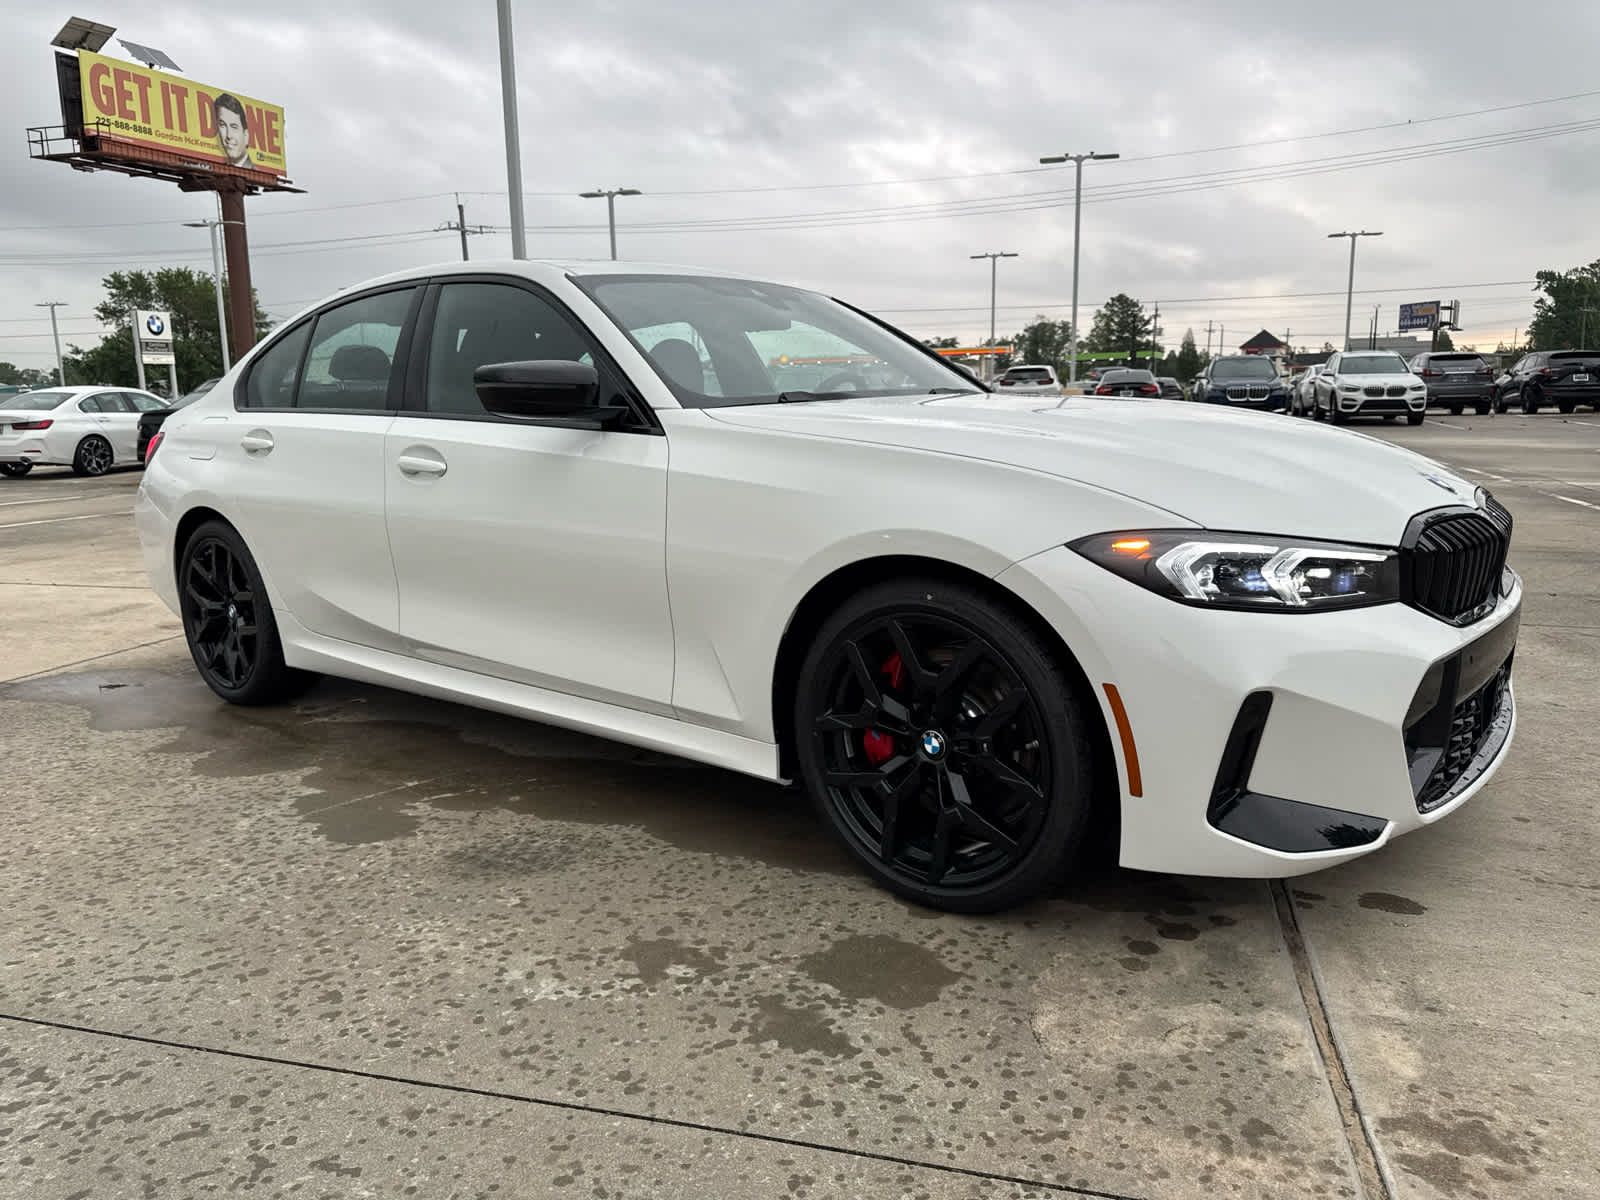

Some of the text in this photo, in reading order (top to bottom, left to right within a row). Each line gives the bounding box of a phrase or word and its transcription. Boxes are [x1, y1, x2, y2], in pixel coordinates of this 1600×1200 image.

[89, 63, 281, 154] GET IT DNE
